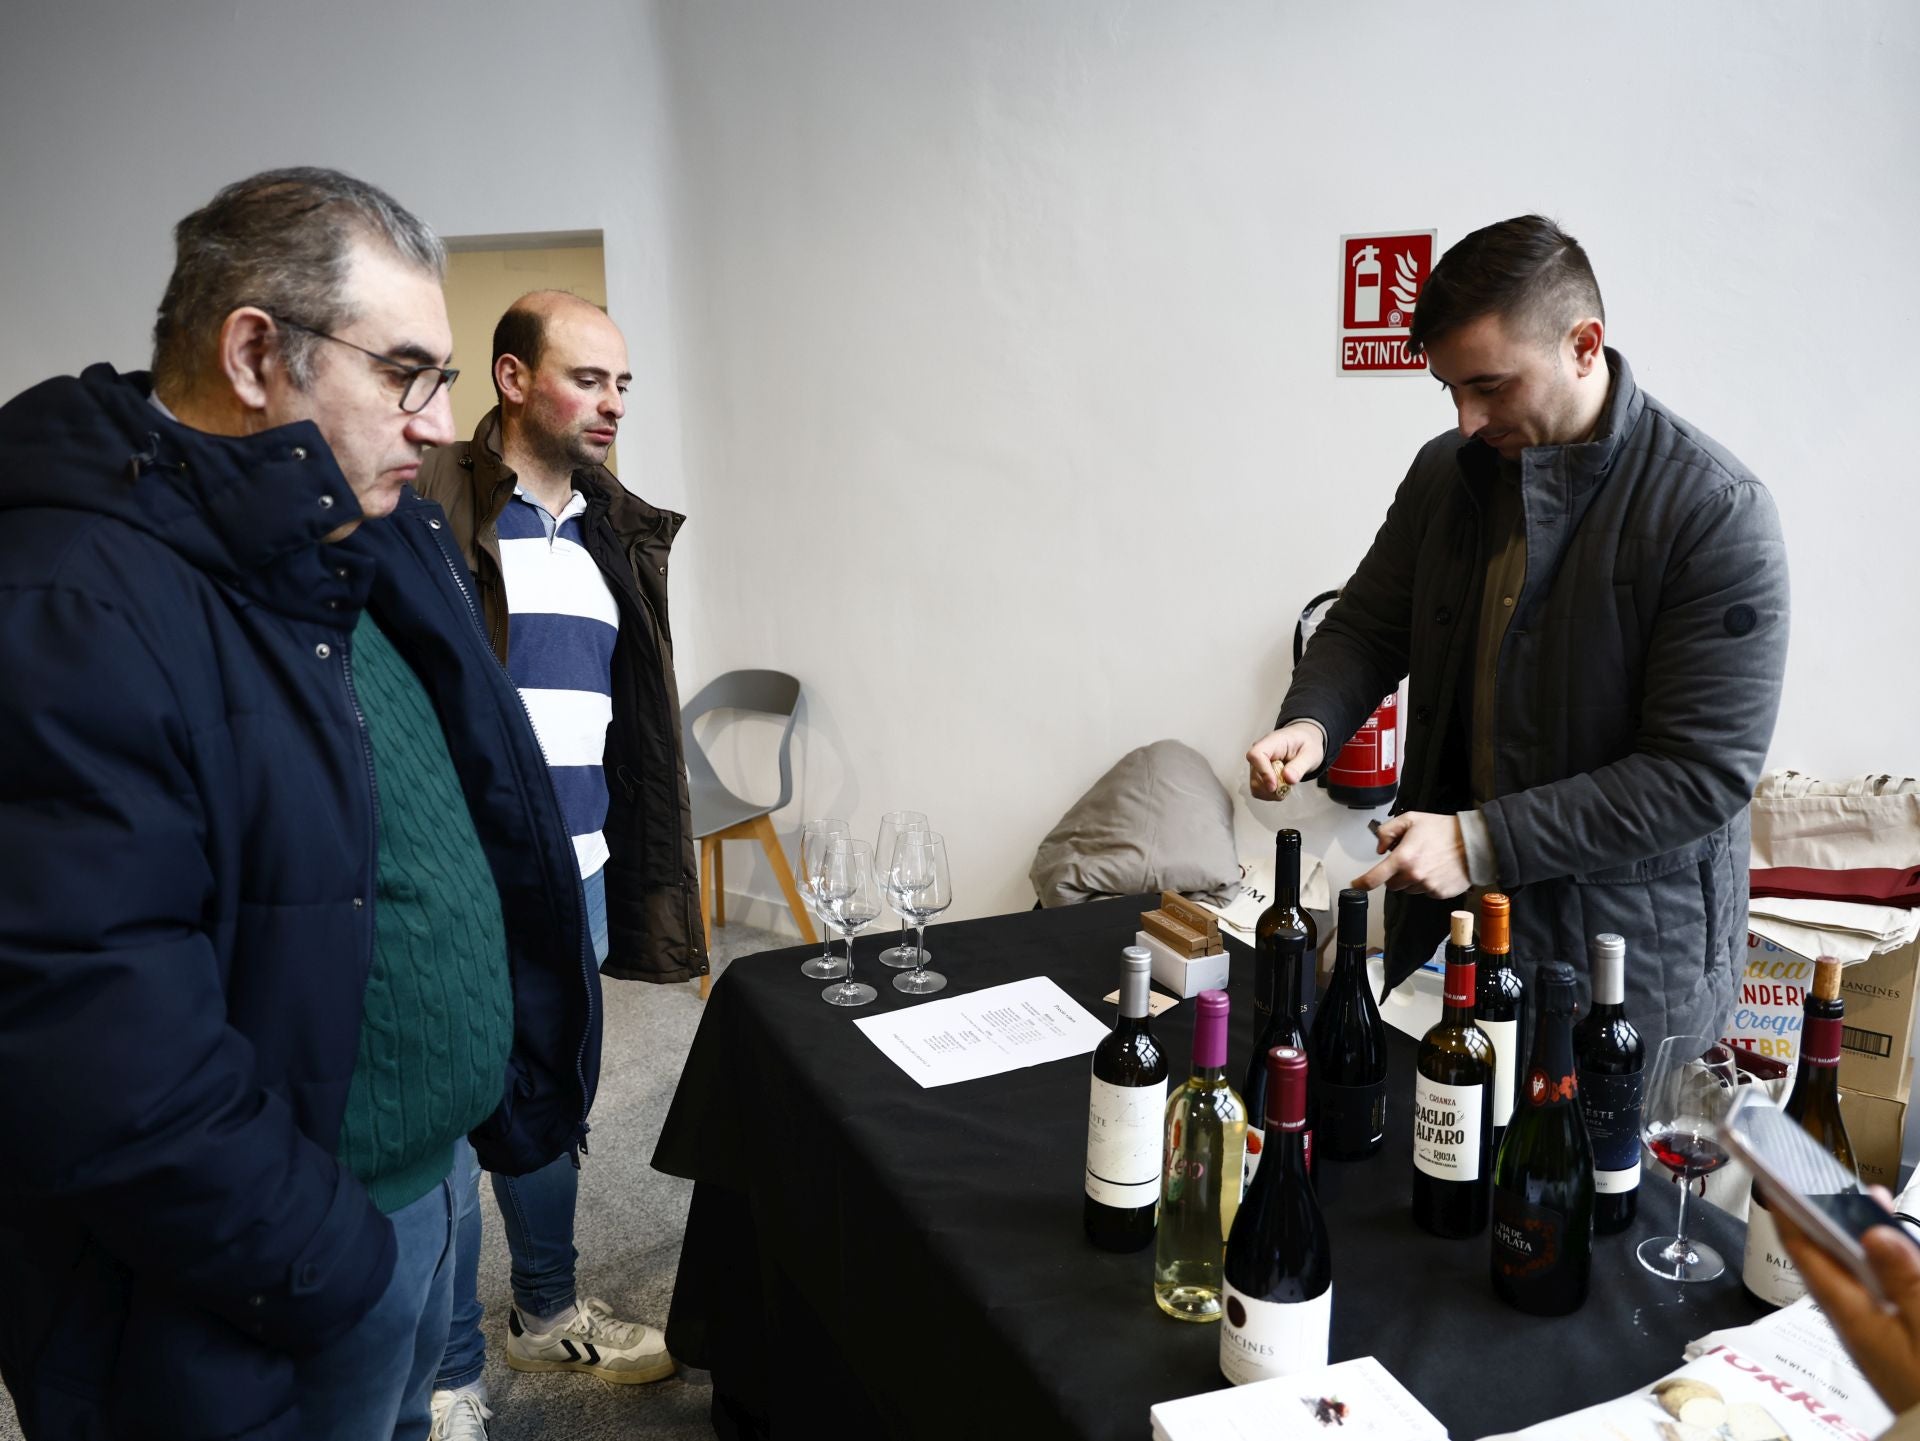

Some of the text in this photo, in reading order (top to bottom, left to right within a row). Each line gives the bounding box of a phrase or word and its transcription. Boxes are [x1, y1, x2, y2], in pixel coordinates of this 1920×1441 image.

[1416, 1122, 1464, 1144] ALFARO
[1433, 1150, 1456, 1162] RIOJA
[1503, 1232, 1532, 1252] PLATA
